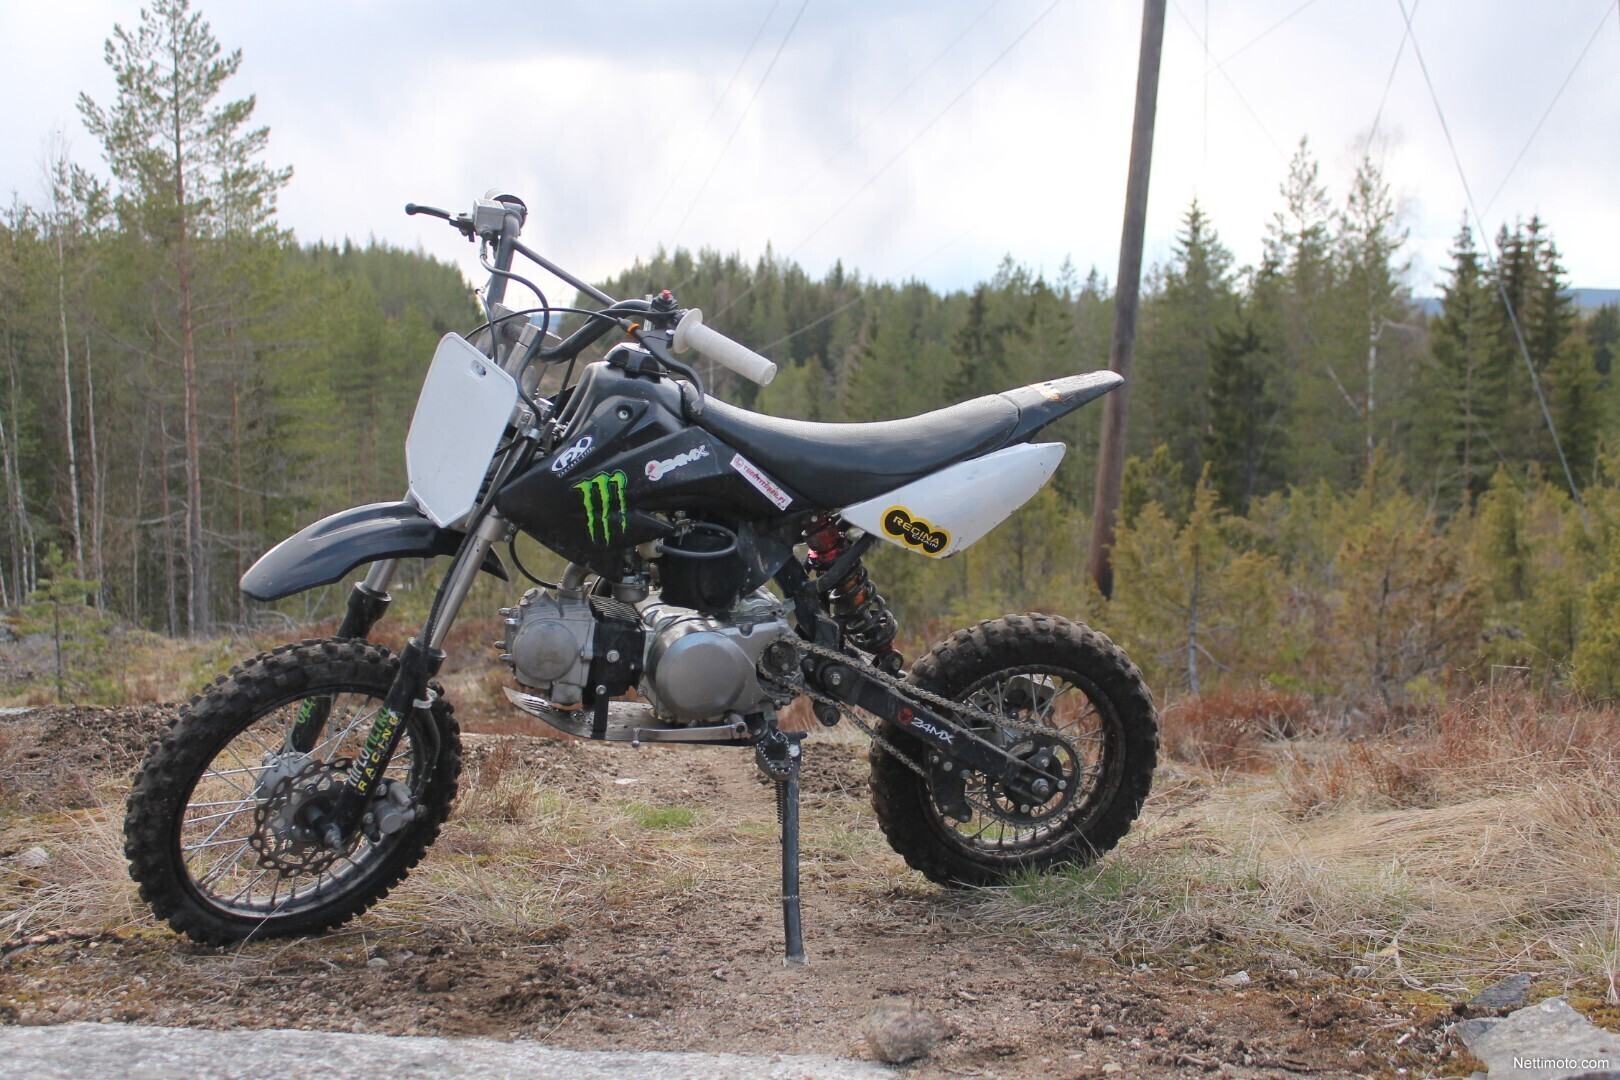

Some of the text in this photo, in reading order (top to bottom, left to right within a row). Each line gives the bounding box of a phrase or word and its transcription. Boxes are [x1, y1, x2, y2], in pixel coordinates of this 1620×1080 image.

[892, 515, 940, 545] REGINA
[911, 533, 939, 548] CHAIN
[911, 716, 955, 745] 24MX
[357, 716, 399, 791] RACING
